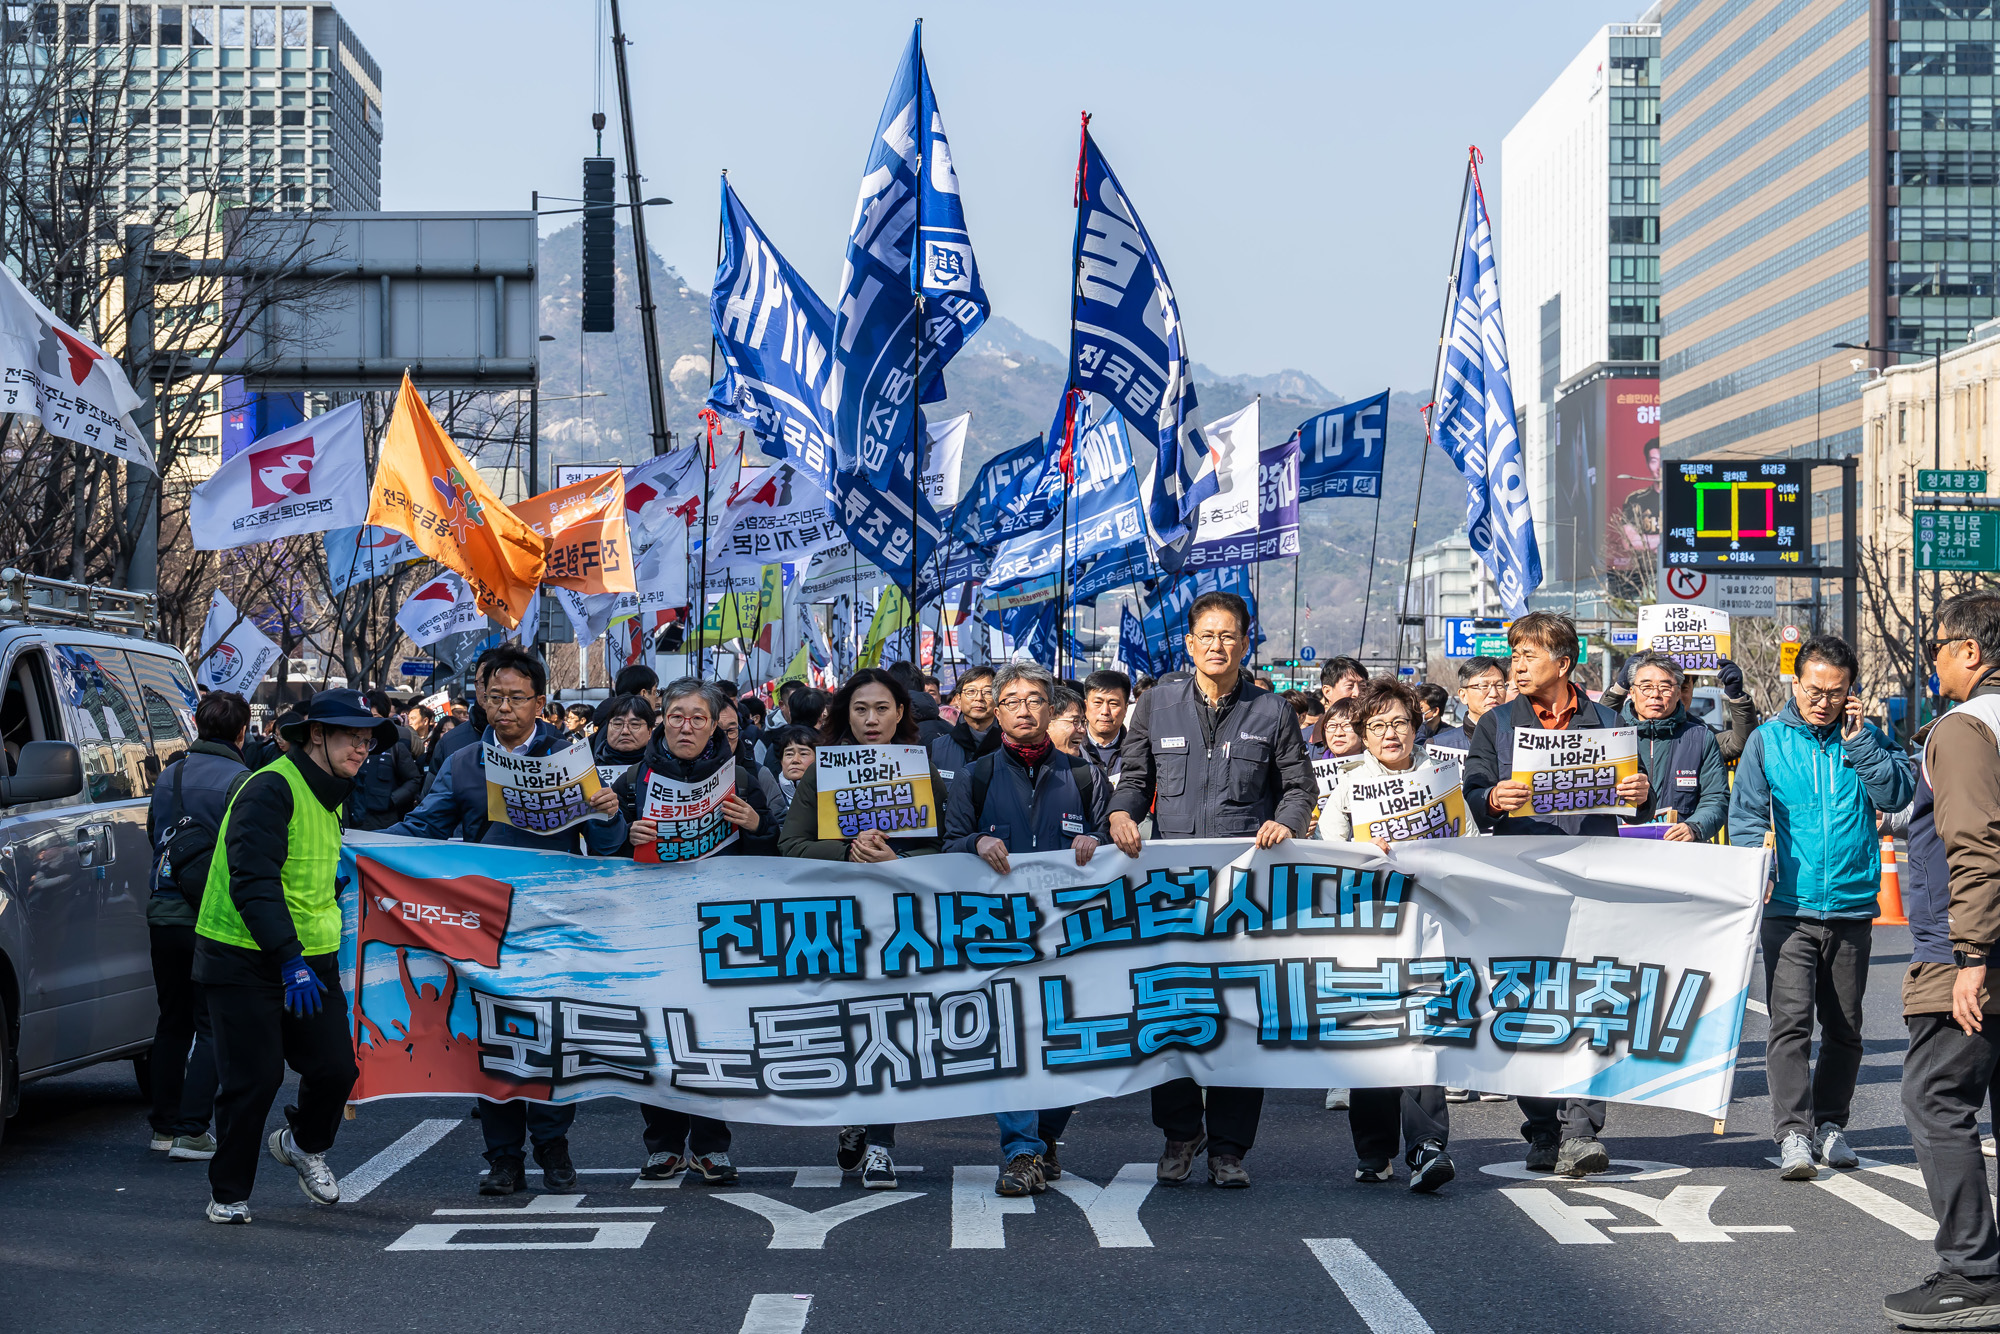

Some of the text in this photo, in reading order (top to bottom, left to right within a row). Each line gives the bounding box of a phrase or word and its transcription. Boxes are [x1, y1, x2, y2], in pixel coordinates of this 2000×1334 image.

[1680, 464, 1713, 475] 독립문역
[1723, 472, 1748, 482] 광화문
[1761, 464, 1786, 475] 창경궁
[1684, 474, 1698, 482] 6분
[1927, 474, 1980, 489] 청계광장
[1778, 484, 1799, 494] 이화4
[1779, 494, 1796, 502] 11분
[1922, 517, 1933, 527] 21
[1937, 515, 1982, 531] 독립문
[1777, 526, 1795, 536] 종로
[1922, 531, 1932, 540] 50
[1685, 538, 1695, 547] 역
[1777, 537, 1792, 547] 5가
[1937, 532, 1981, 548] 광화문
[1669, 552, 1699, 563] 창경궁
[1730, 552, 1756, 563] 이화4
[1780, 552, 1799, 562] 서행
[1937, 548, 1966, 558] 光化門
[1749, 585, 1773, 595] 22:00
[1665, 607, 1689, 618] 사장
[1665, 619, 1707, 632] 나와라!
[1785, 630, 1796, 639] 50
[1652, 635, 1716, 652] 원청교섭
[1550, 745, 1606, 767] 나와라!
[514, 766, 570, 789] 나와라!
[848, 761, 901, 785] 나와라!
[1532, 766, 1615, 793] 원청교섭
[650, 777, 720, 802] 모든 노동자의
[502, 784, 584, 811] 원청교섭
[835, 783, 913, 812] 원청교섭
[1379, 785, 1433, 816] 나와라!
[650, 798, 711, 819] 노동기본권
[657, 805, 727, 839] 투쟁으로
[838, 806, 927, 837] 쟁취하자!
[1369, 802, 1447, 842] 원청교섭
[657, 820, 732, 862] 쟁취하자!
[402, 901, 481, 930] 민주노총
[697, 896, 868, 983] 진짜
[880, 891, 1043, 976] 사장
[470, 987, 655, 1084] 모든
[663, 977, 1026, 1096] 노동자의
[1489, 956, 1711, 1060] 쟁취!
